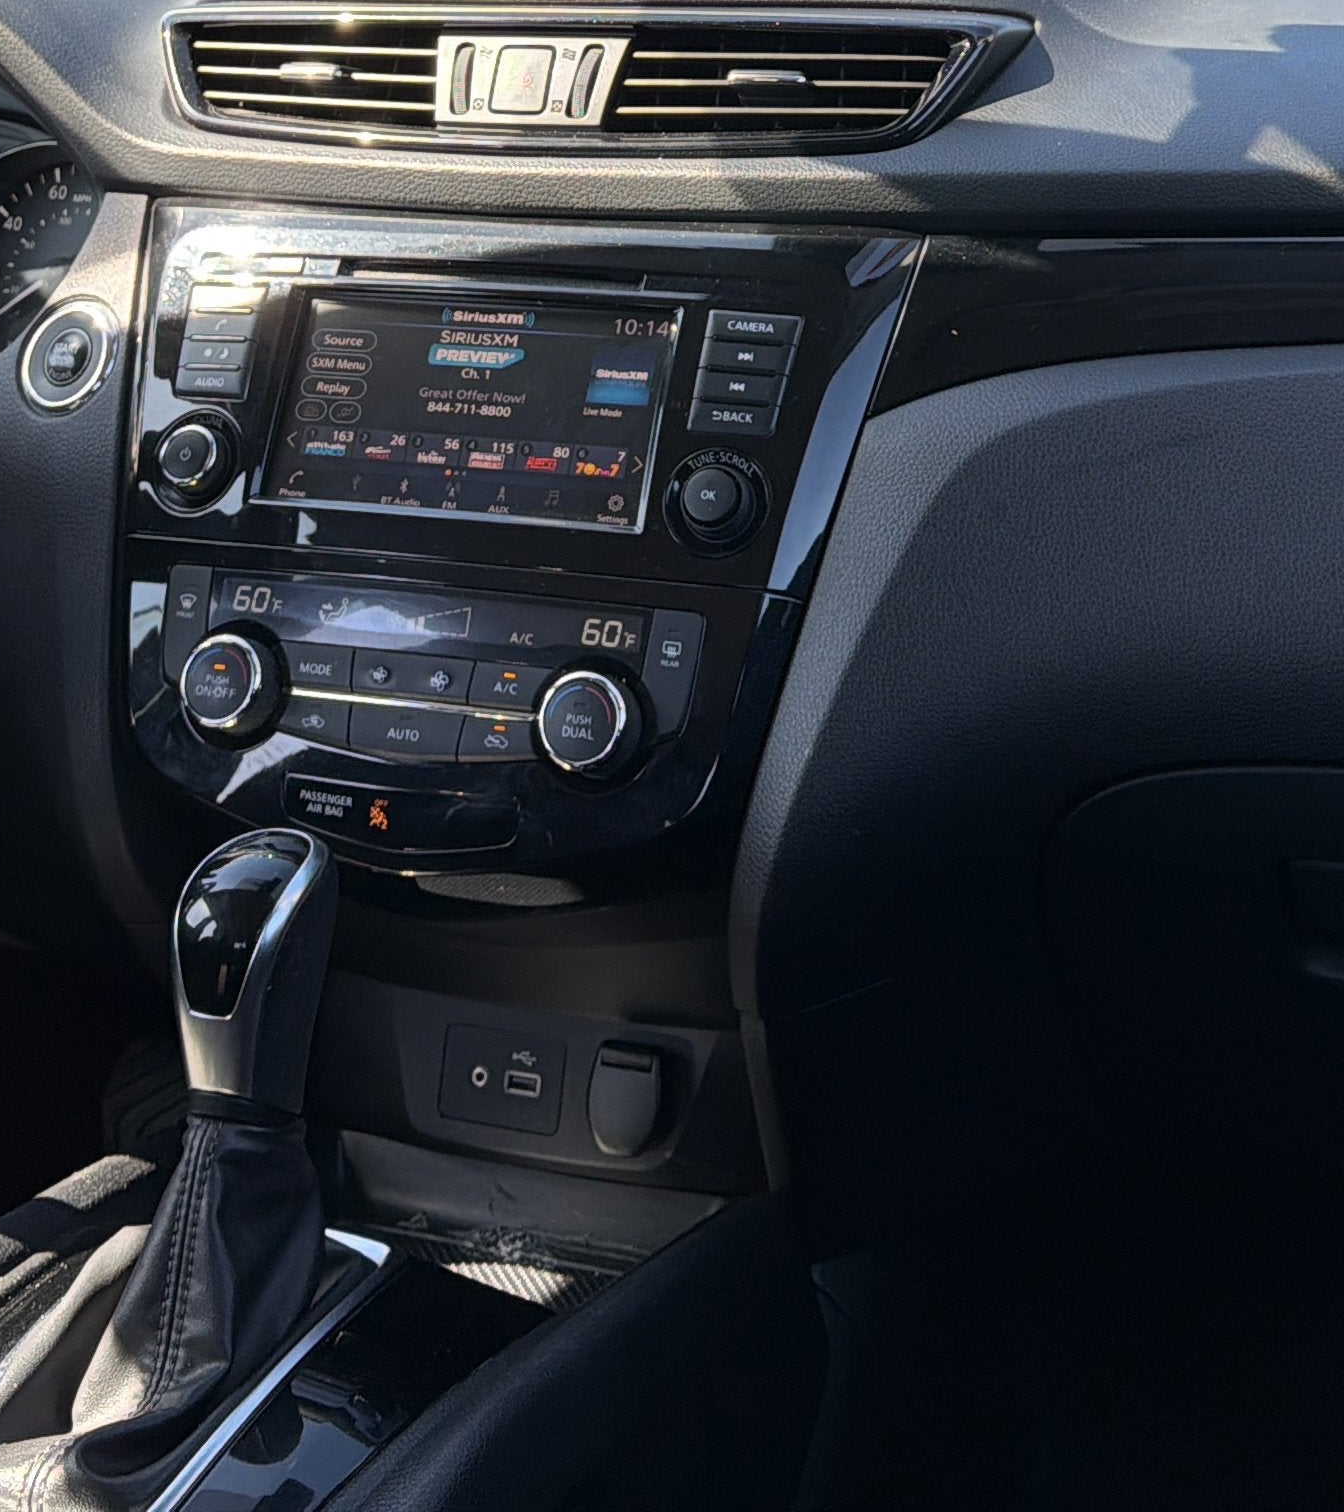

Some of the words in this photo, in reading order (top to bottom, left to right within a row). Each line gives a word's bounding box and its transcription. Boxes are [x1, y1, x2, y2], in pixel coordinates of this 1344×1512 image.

[48, 185, 68, 200] 60
[2, 216, 23, 231] 40
[615, 318, 669, 337] 10:14
[727, 320, 775, 334] CAMERA
[323, 334, 365, 347] Source
[440, 330, 519, 348] SIRIUSXM
[436, 348, 516, 365] PREVIEW
[312, 357, 335, 369] SXM
[336, 358, 366, 371] Menu
[461, 368, 481, 380] Ch.
[484, 369, 491, 380] 1
[193, 376, 225, 388] AUDIO
[316, 381, 351, 396] Replay
[419, 387, 454, 401] Great
[456, 389, 491, 403] Offer
[493, 391, 527, 405] Now!
[426, 401, 512, 418] 844-711-8800
[582, 406, 598, 417] Live
[600, 407, 623, 419] Mode
[723, 411, 754, 424] BACK
[333, 430, 355, 443] 163
[389, 434, 407, 447] 26
[443, 438, 461, 451] 56
[492, 441, 515, 455] 115
[552, 446, 571, 459] 80
[617, 450, 627, 463] 7
[278, 487, 307, 498] Phone
[701, 489, 717, 501] OK
[380, 495, 393, 505] BT
[394, 496, 421, 508] Audio
[487, 504, 510, 515] AUX
[596, 513, 629, 526] Settings
[509, 631, 534, 646] A/C
[299, 661, 333, 677] MODE
[205, 674, 230, 684] PUSH
[493, 681, 518, 696] A/C
[565, 713, 593, 725] PUSH
[386, 727, 421, 742] AUTO
[561, 724, 595, 741] DUAL
[299, 789, 353, 808] PASSENGER
[306, 802, 324, 815] AIR
[324, 804, 344, 818] BAG
